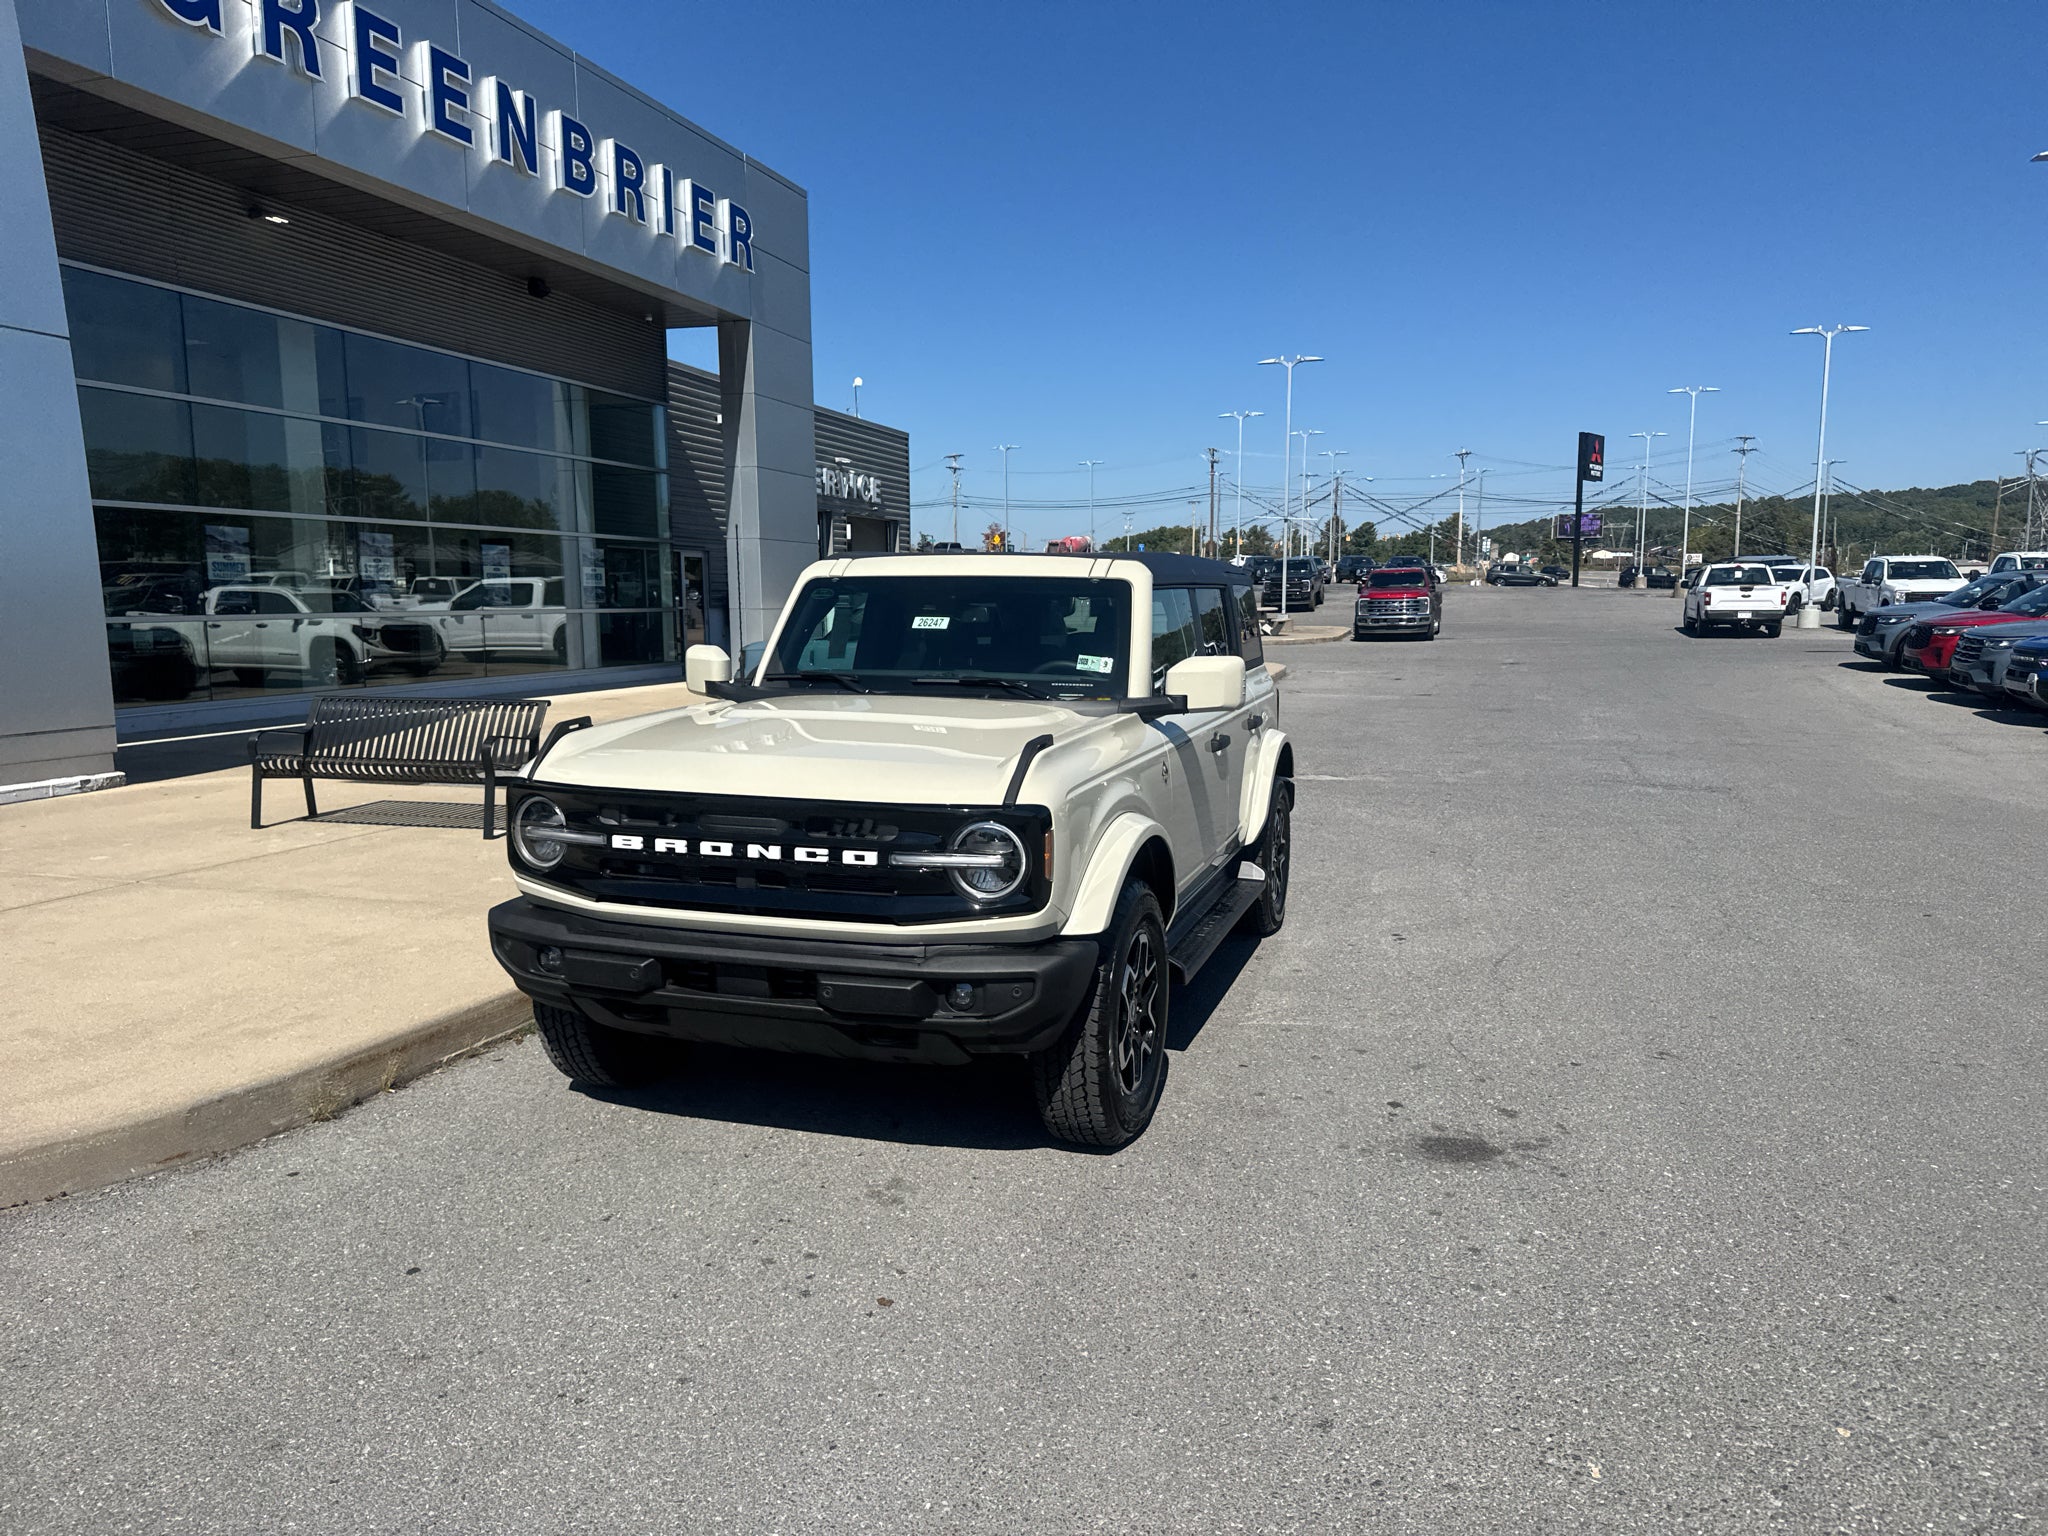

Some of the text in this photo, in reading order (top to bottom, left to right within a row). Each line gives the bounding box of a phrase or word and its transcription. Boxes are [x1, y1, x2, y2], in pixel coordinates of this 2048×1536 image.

[150, 0, 756, 274] REENBRIER
[917, 618, 945, 628] 26247
[611, 834, 879, 866] BRONCO
